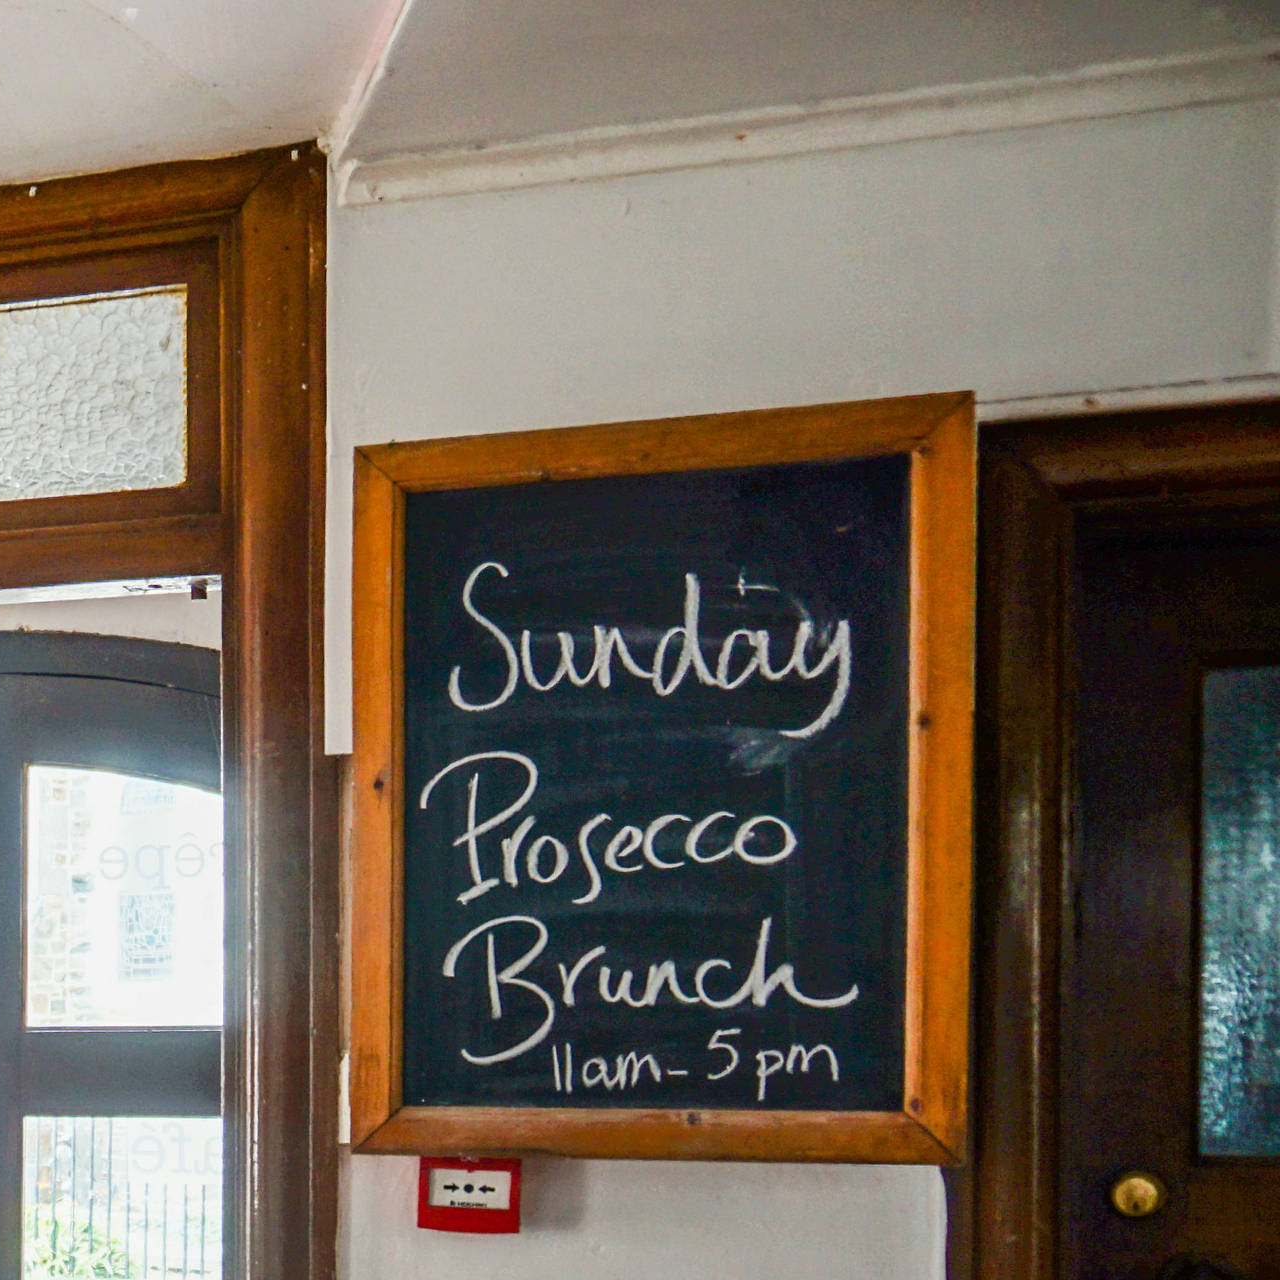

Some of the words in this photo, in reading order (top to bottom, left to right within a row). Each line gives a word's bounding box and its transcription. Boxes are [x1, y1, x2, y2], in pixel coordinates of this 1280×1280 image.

[448, 561, 851, 738] Sunday
[419, 750, 798, 905] Prosecco
[443, 914, 860, 1066] Brunch
